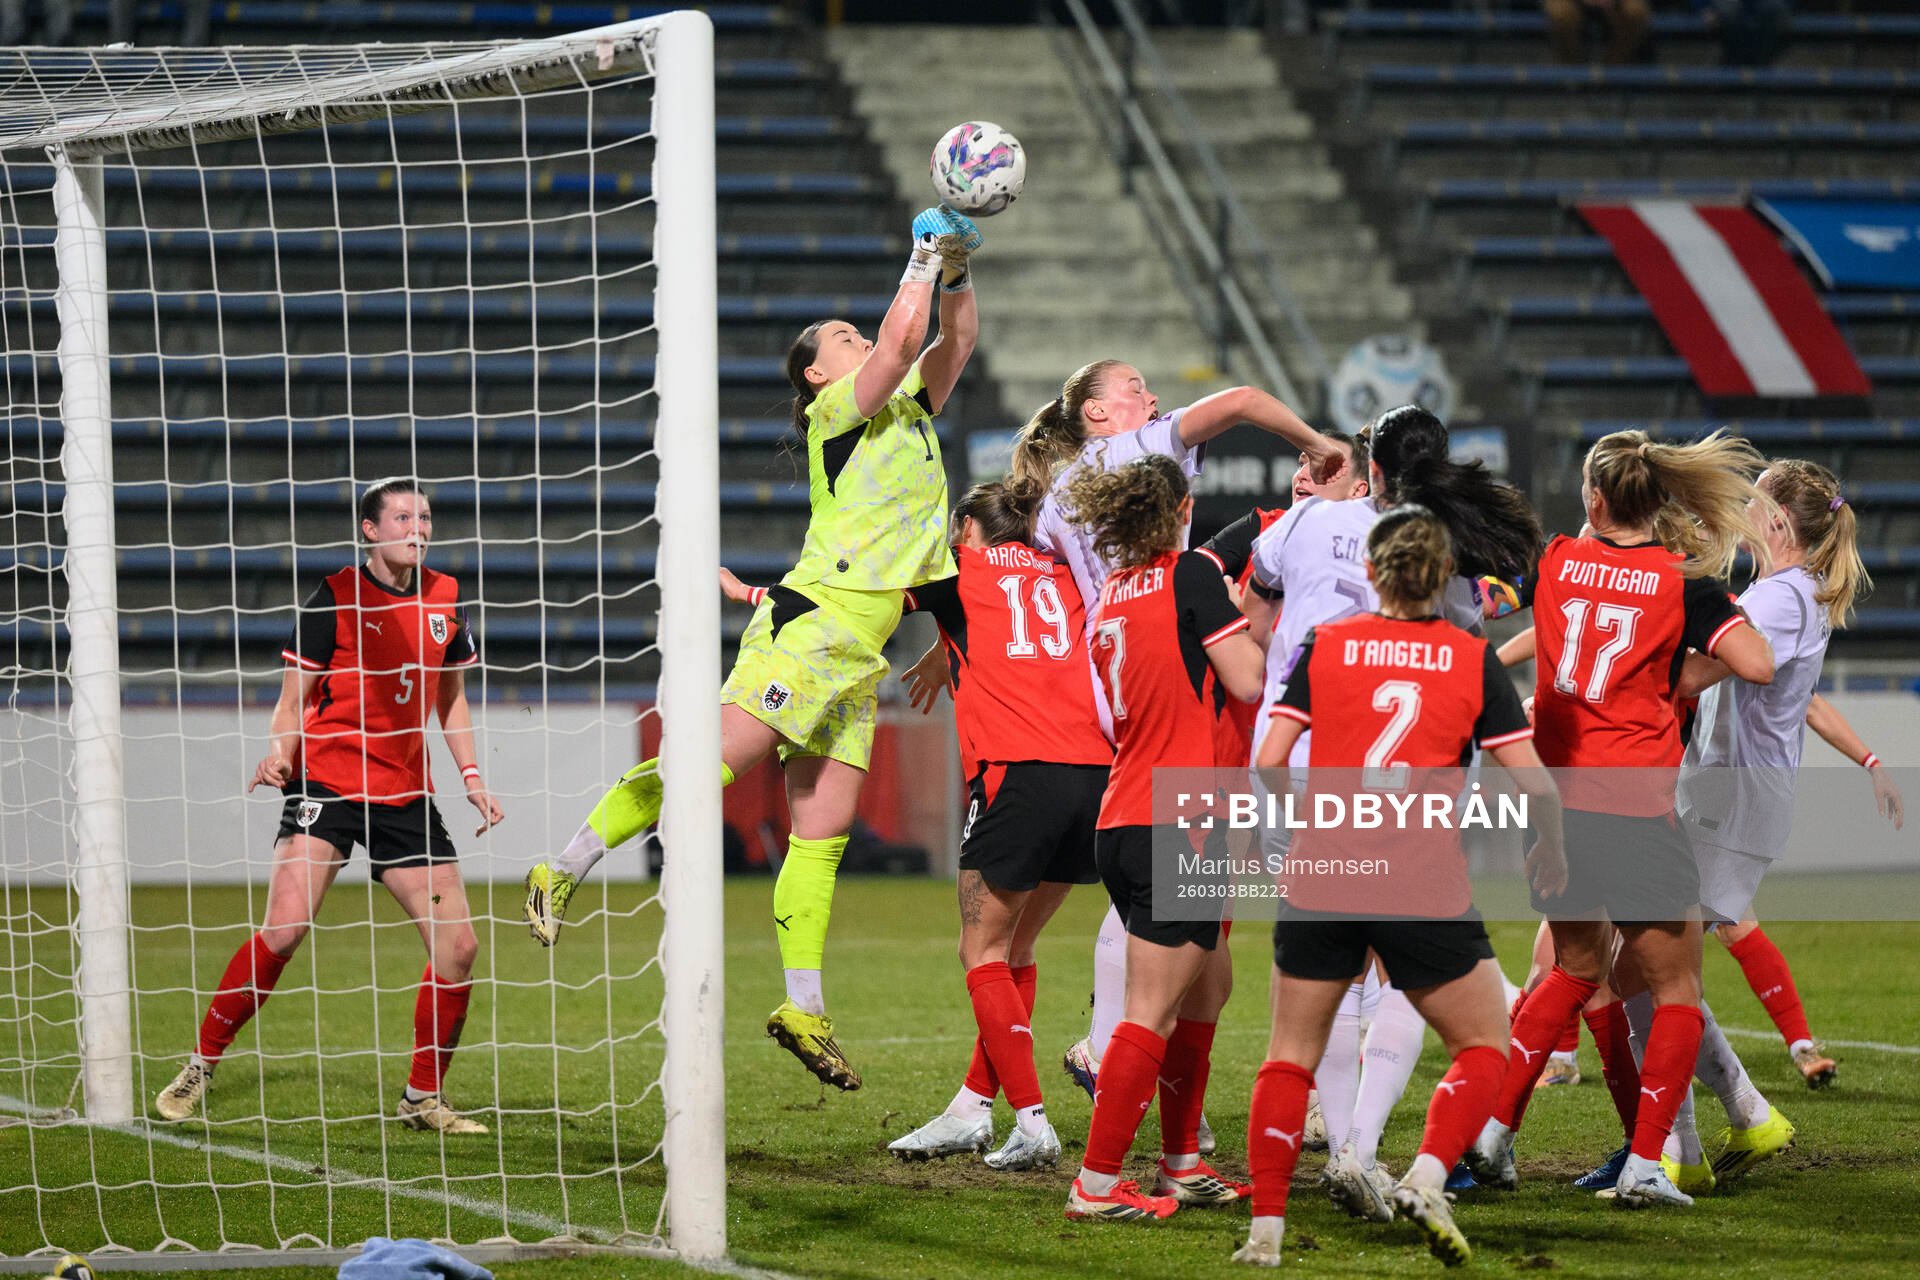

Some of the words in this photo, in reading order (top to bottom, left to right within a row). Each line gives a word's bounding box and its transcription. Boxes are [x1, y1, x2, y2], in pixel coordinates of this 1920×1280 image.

[915, 419, 933, 461] 1
[1558, 560, 1660, 596] PUNTIGAM
[997, 574, 1072, 661] 19
[1099, 616, 1127, 720] 7
[1344, 639, 1453, 673] D'ANGELO
[1554, 598, 1644, 703] 17
[395, 663, 417, 704] 5
[1361, 679, 1422, 793] 2
